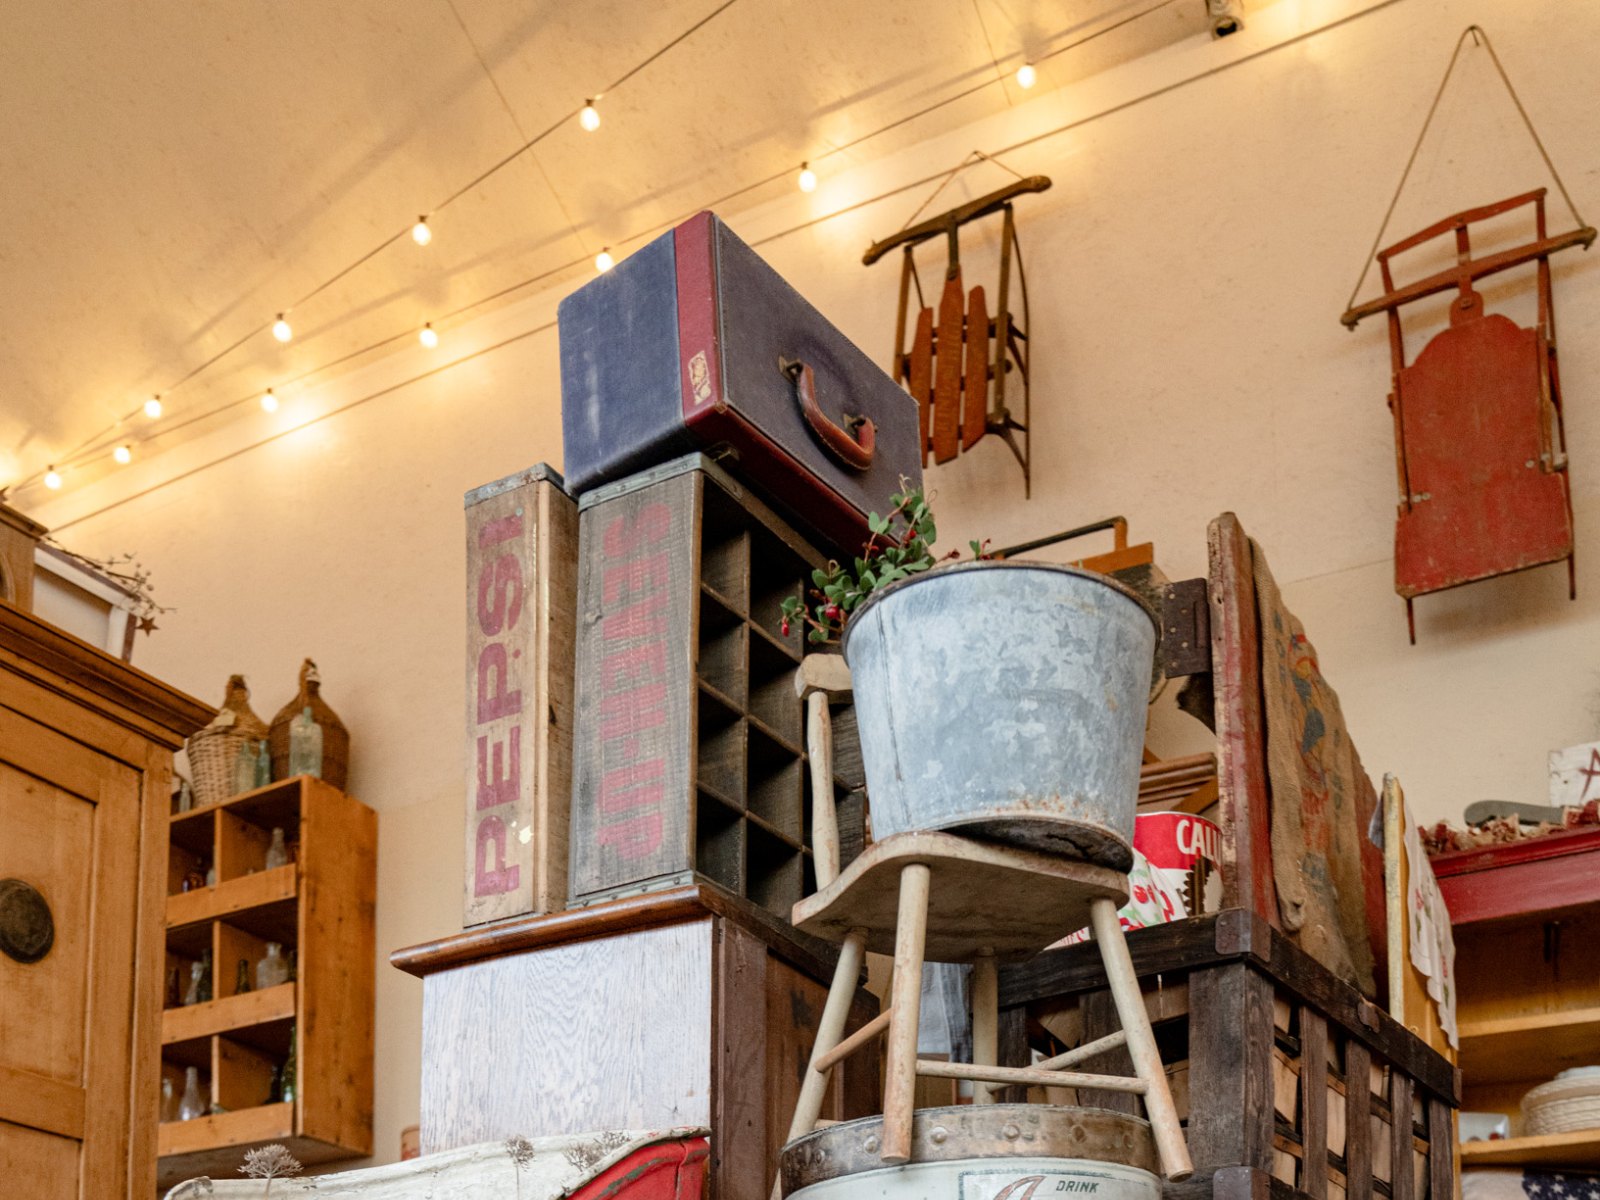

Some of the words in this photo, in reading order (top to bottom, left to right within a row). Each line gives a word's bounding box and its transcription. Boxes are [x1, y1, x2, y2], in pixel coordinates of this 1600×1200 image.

[475, 515, 523, 898] PEPSI
[596, 502, 672, 861] SEVEN-UP
[1056, 1180, 1099, 1194] DRINK
